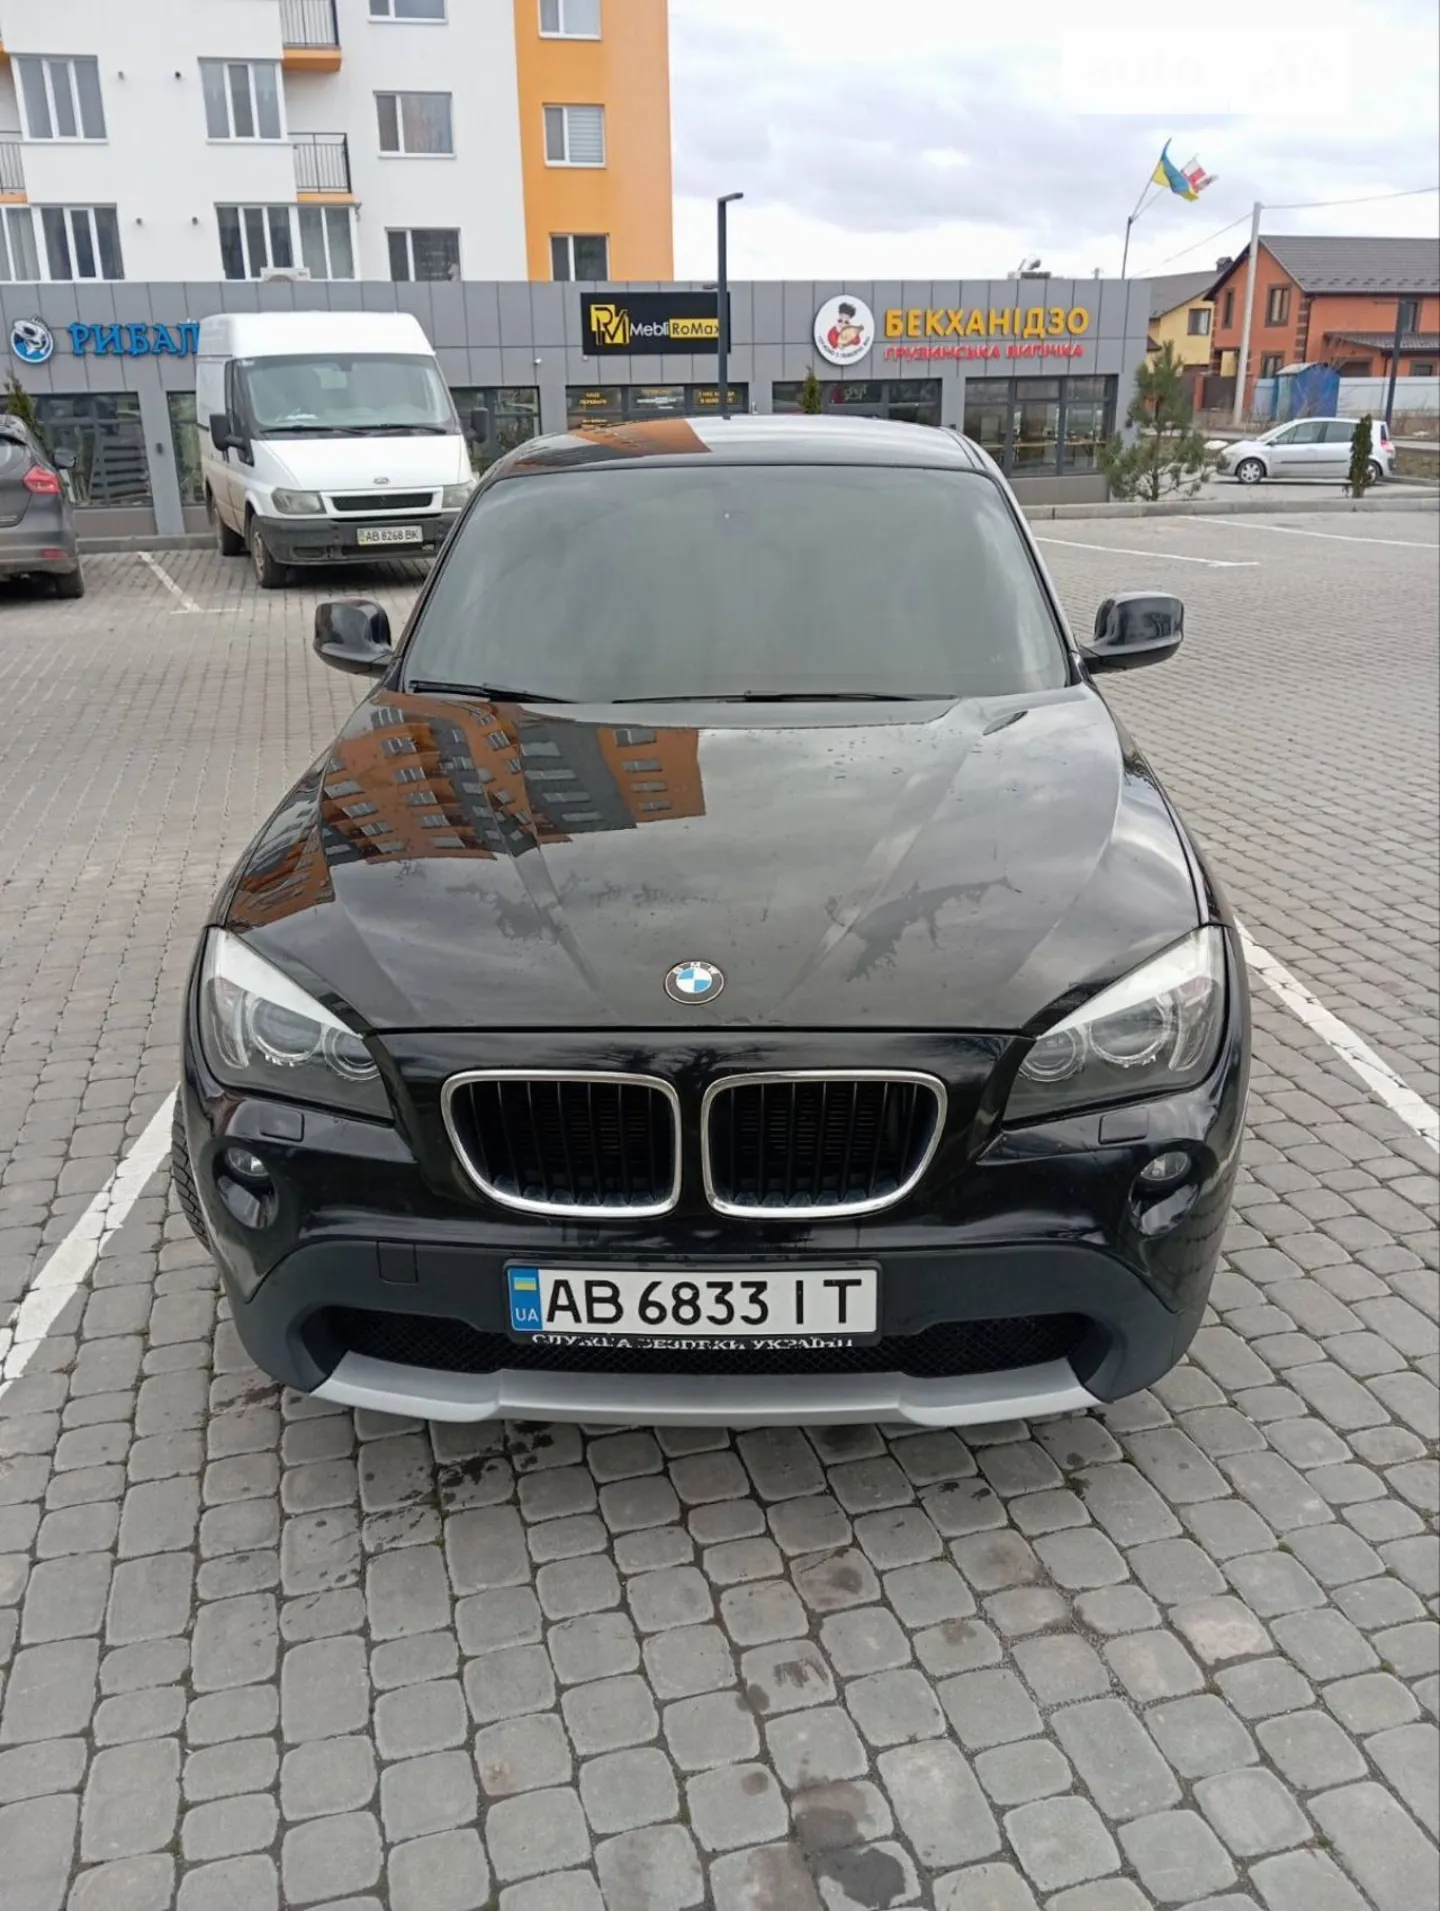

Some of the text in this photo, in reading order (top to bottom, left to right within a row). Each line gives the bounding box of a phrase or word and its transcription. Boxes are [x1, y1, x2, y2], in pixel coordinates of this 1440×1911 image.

[885, 306, 1090, 340] БЕКХАНІДЗО
[883, 344, 1000, 363] ГРУЗИНСЬКА
[1006, 342, 1085, 360] ВИПІЧКА
[366, 530, 380, 542] AB
[405, 529, 419, 540] BK
[546, 1279, 862, 1326] AB 6833 IT
[515, 1307, 540, 1323] UA
